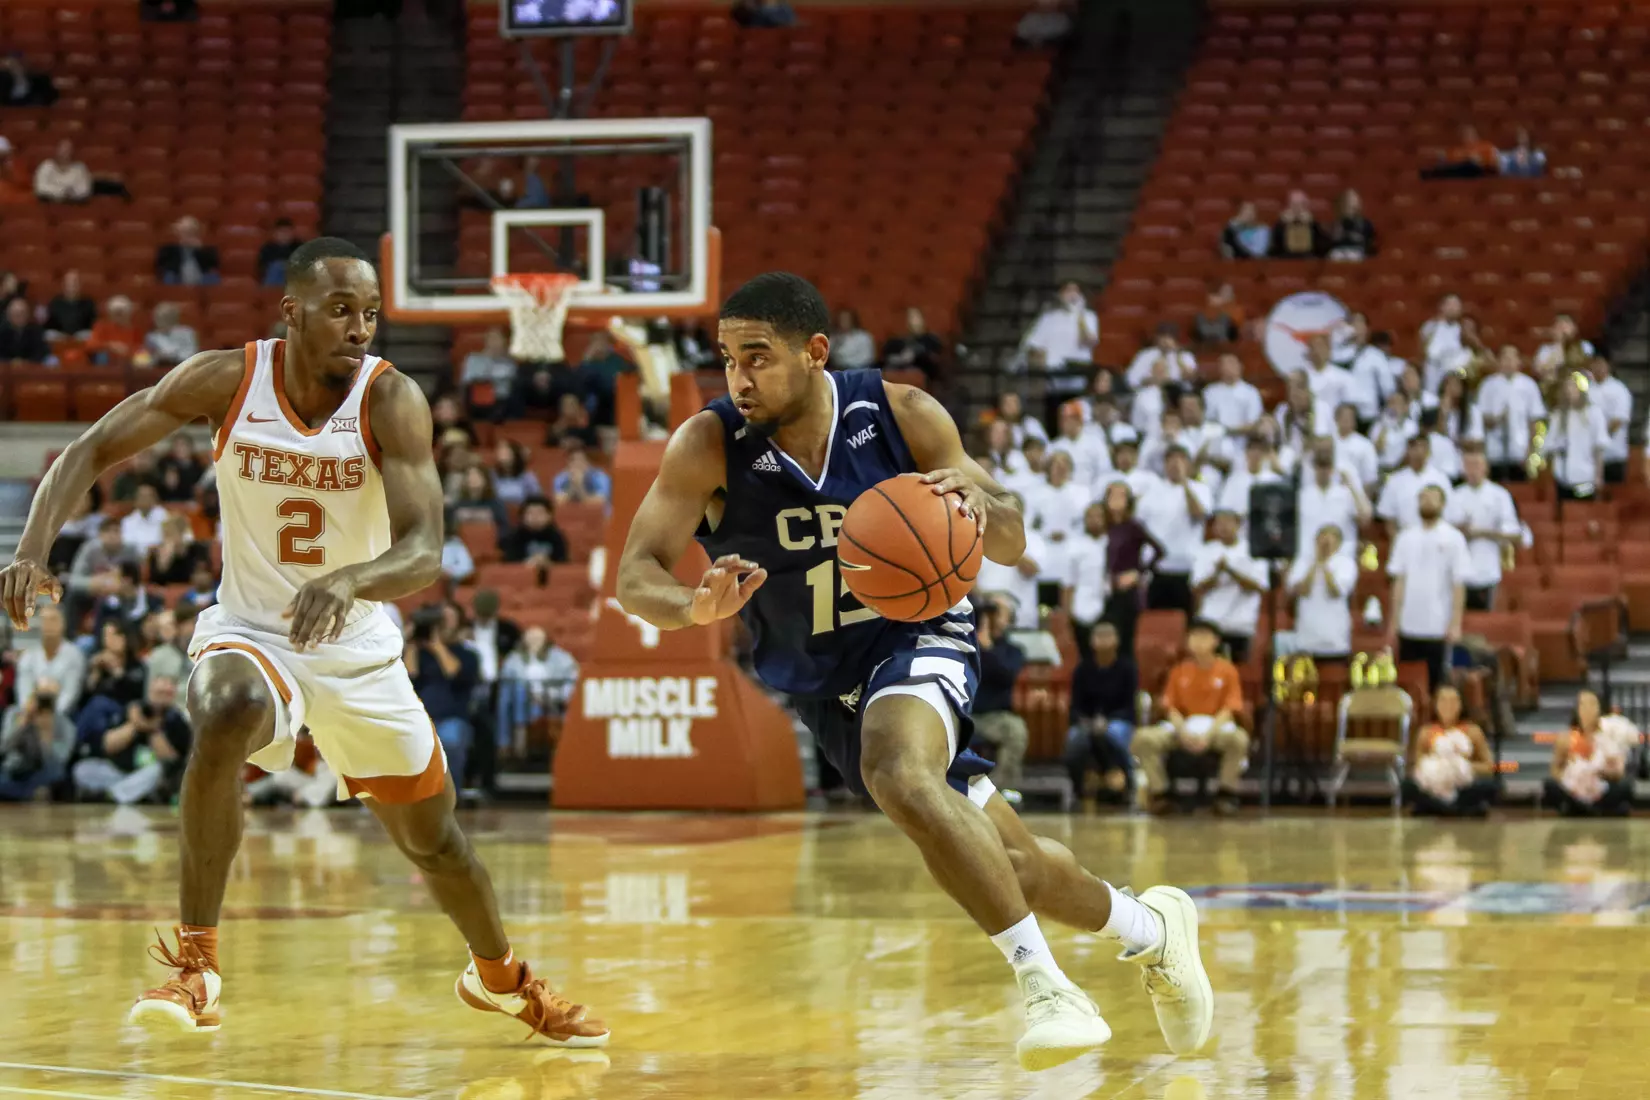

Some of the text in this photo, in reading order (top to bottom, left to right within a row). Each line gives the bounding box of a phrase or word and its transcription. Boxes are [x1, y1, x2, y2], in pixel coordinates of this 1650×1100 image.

[846, 423, 878, 449] WAC
[234, 442, 366, 491] TEXAS
[752, 462, 781, 472] adidas
[276, 498, 325, 566] 2
[776, 504, 848, 551] CB
[583, 677, 718, 719] MUSCLE
[607, 717, 694, 759] MILK
